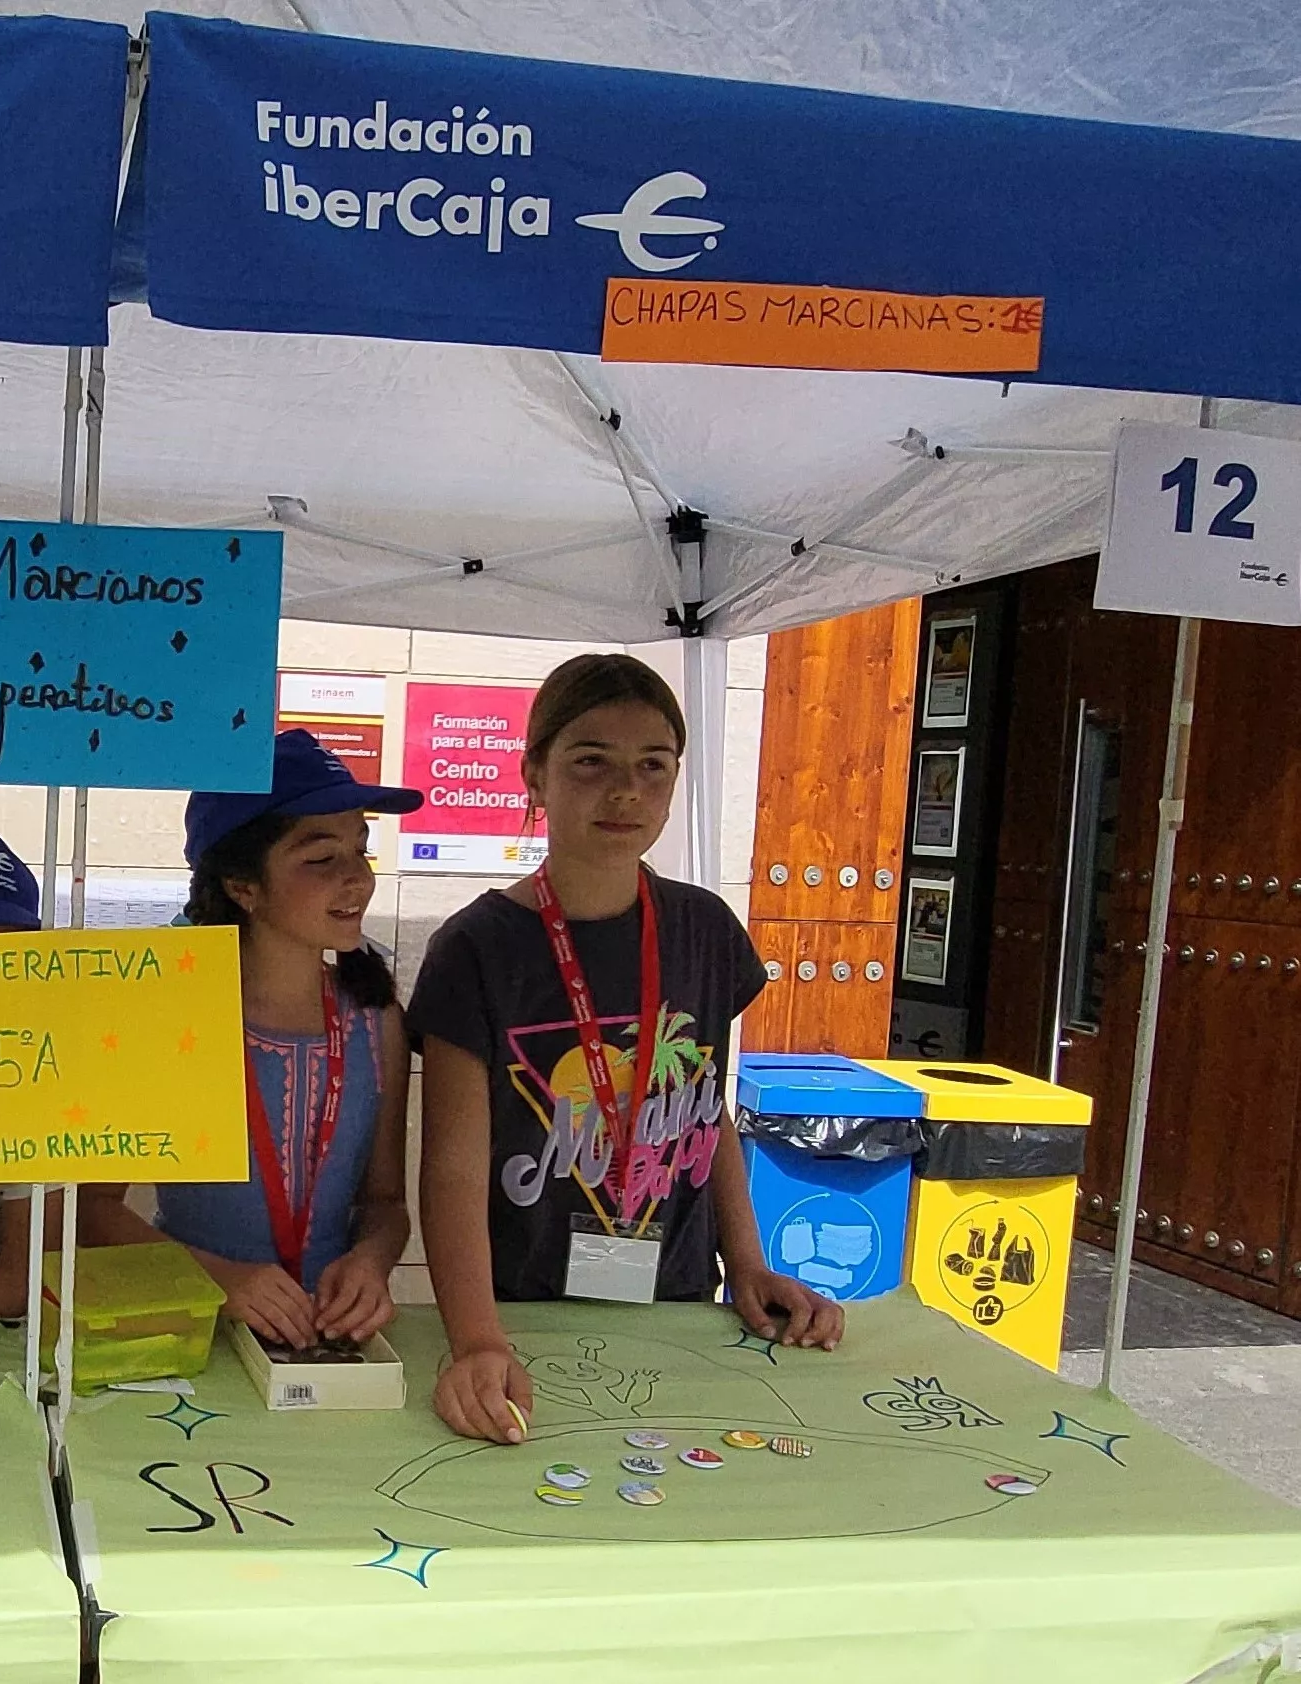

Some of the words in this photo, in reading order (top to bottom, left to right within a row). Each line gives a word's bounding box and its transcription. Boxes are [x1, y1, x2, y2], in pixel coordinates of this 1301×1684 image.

[256, 100, 533, 156] Fundación
[262, 160, 550, 253] iberCaja
[610, 286, 748, 326] CHAPAS
[759, 295, 996, 333] MARCIANAS:
[1160, 456, 1258, 540] 12
[431, 735, 465, 751] para
[467, 735, 481, 749] el
[433, 712, 508, 731] Formación
[430, 758, 499, 780] Centro
[46, 1125, 180, 1163] RAMÍREZ
[139, 1460, 296, 1535] SR
